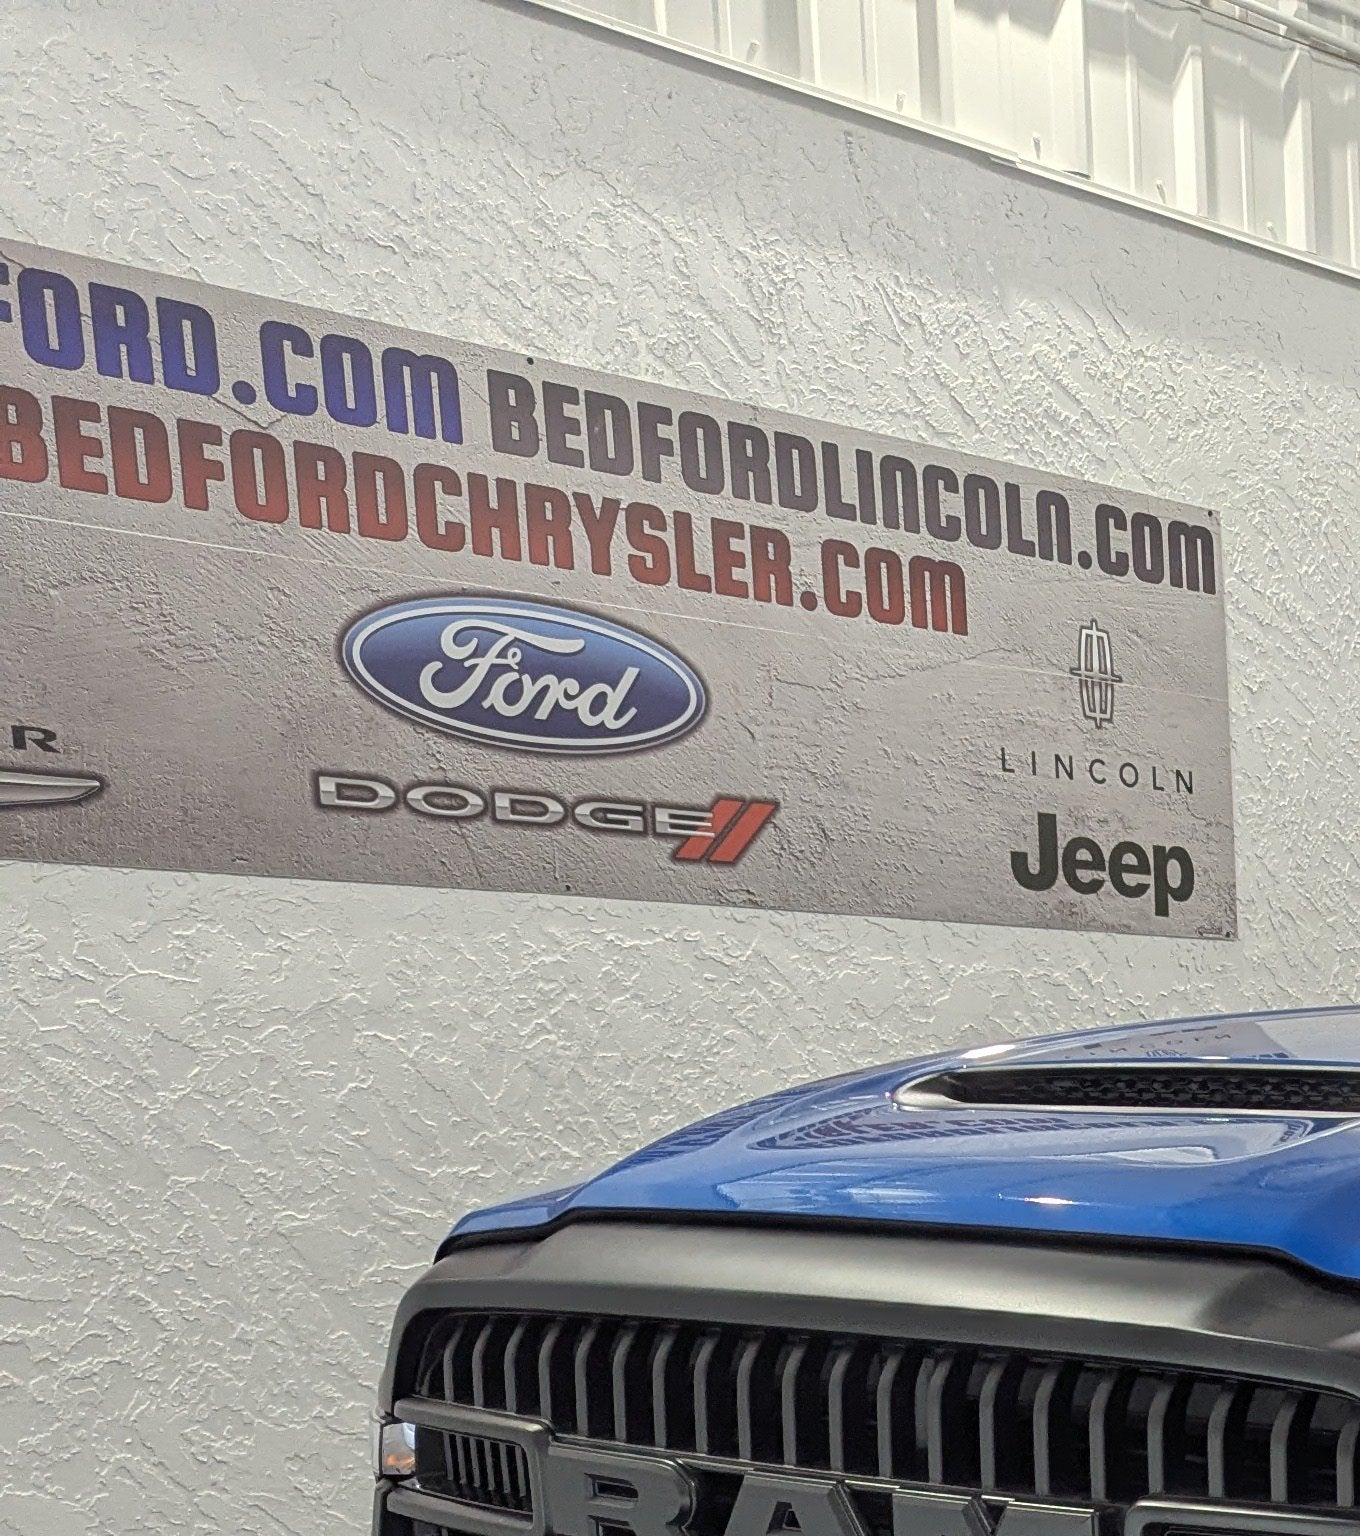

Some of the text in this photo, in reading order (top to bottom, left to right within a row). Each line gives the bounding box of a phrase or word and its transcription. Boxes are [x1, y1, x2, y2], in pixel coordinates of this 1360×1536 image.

[0, 262, 464, 445] ORD.COM
[418, 619, 641, 730] Ford
[318, 775, 716, 838] DODGE
[1000, 747, 1194, 795] LINCOLN
[1010, 811, 1196, 918] Jeep
